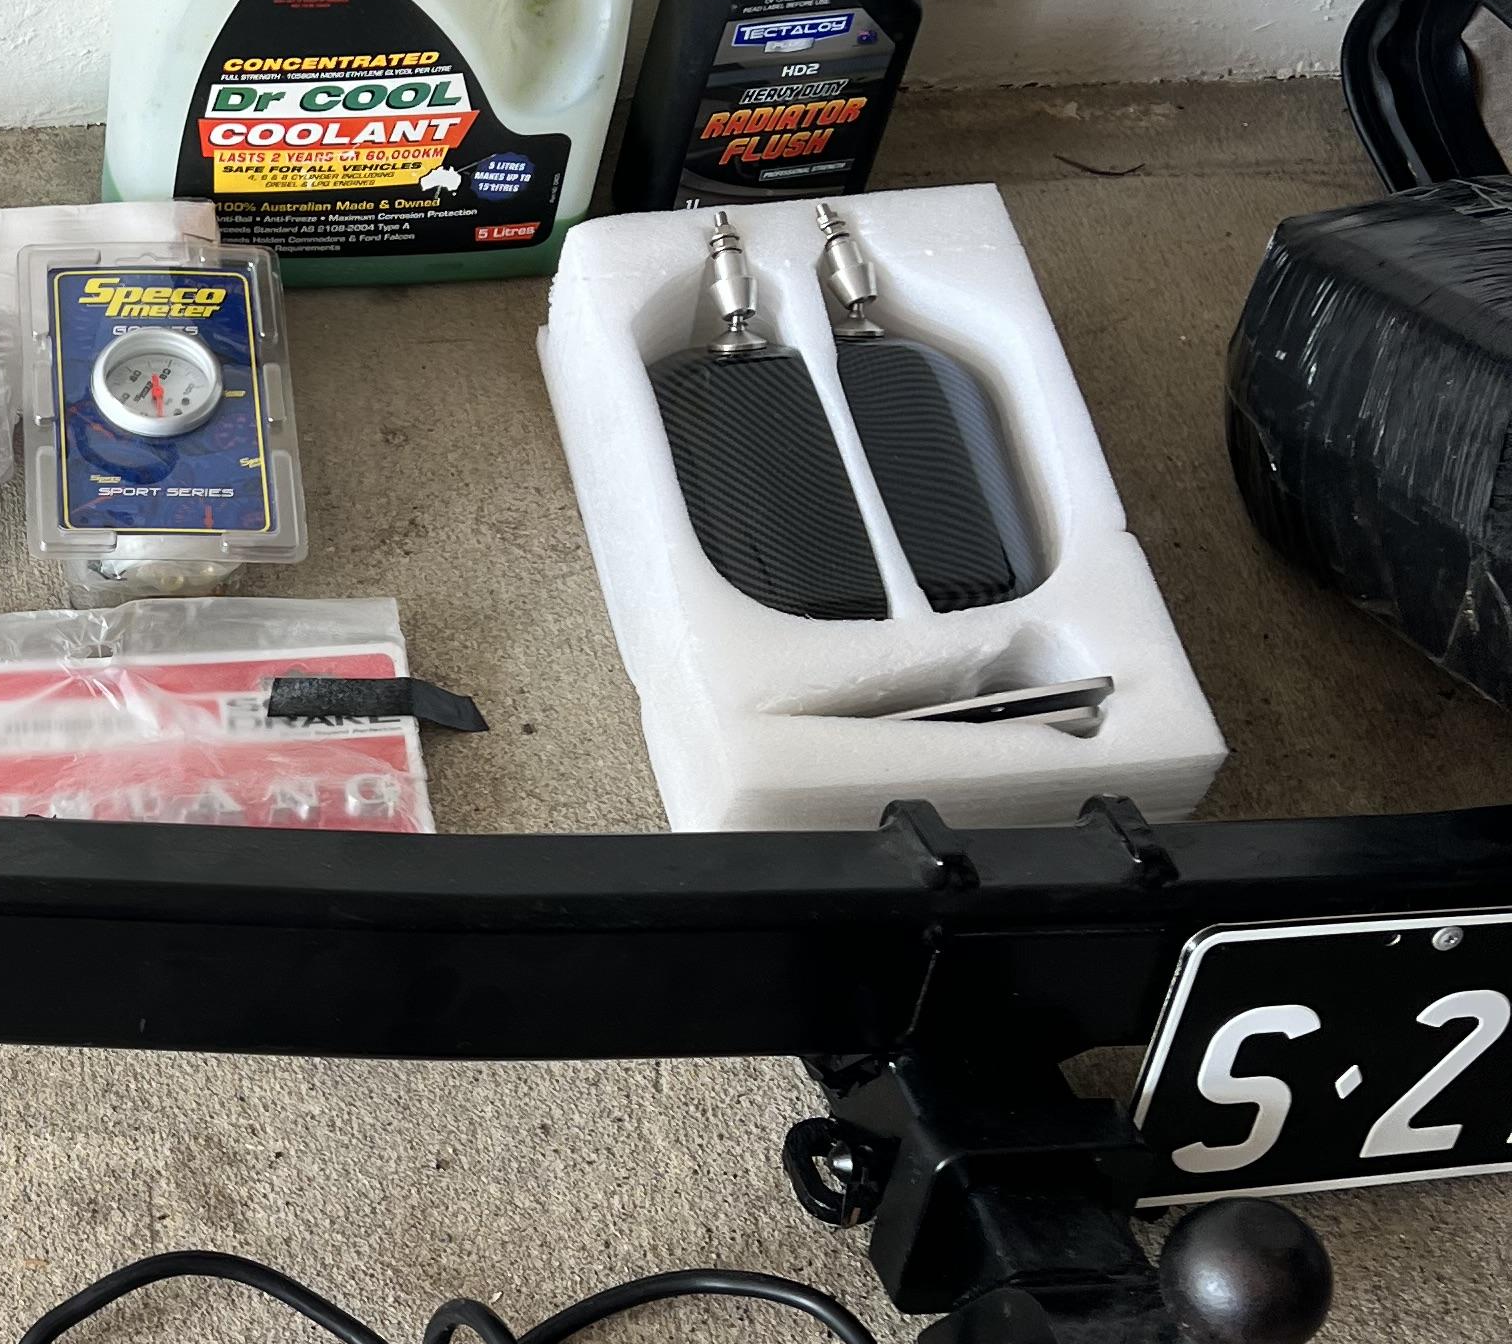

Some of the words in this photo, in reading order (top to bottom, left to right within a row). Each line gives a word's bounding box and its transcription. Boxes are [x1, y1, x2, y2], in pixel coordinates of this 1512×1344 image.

[740, 17, 848, 40] TECTALOY
[223, 51, 441, 73] CONCENTRATED
[781, 63, 820, 77] HD2
[212, 86, 286, 112] Dr
[299, 81, 463, 112] COOL
[739, 85, 802, 105] HEAVY
[800, 79, 850, 98] DUTY
[700, 97, 868, 140] RADIATOR
[209, 117, 462, 147] COOLANT
[718, 128, 835, 166] FLUSH
[218, 151, 265, 164] LASTS
[271, 152, 280, 163] 2
[288, 151, 334, 163] YEARS
[365, 148, 444, 162] 60,000KM
[222, 165, 265, 174] SAFE
[269, 165, 303, 174] FOR
[306, 164, 337, 173] ALL
[343, 162, 423, 173] VEHICLES
[497, 162, 526, 171] LITRES
[474, 171, 505, 181] MAKES
[506, 173, 519, 181] UP
[520, 174, 531, 182] TO
[217, 202, 256, 212] 100%
[260, 202, 332, 212] Australian
[336, 200, 375, 211] Made
[378, 199, 390, 210] &
[394, 198, 441, 209] Owned
[328, 214, 376, 222] Maximum
[377, 211, 425, 221] Corrosion
[427, 208, 478, 219] Protection
[253, 225, 298, 234] Standard
[377, 223, 400, 232] Type
[402, 222, 410, 230] A
[478, 227, 489, 239] 5
[493, 226, 536, 238] Litres
[252, 235, 286, 244] Holden
[288, 235, 346, 244] Commodore
[359, 233, 382, 242] Ford
[384, 233, 416, 241] Falcon
[78, 277, 228, 317] Speco
[122, 304, 222, 318] meter
[98, 488, 161, 497] SPORT
[166, 488, 235, 498] SERIES
